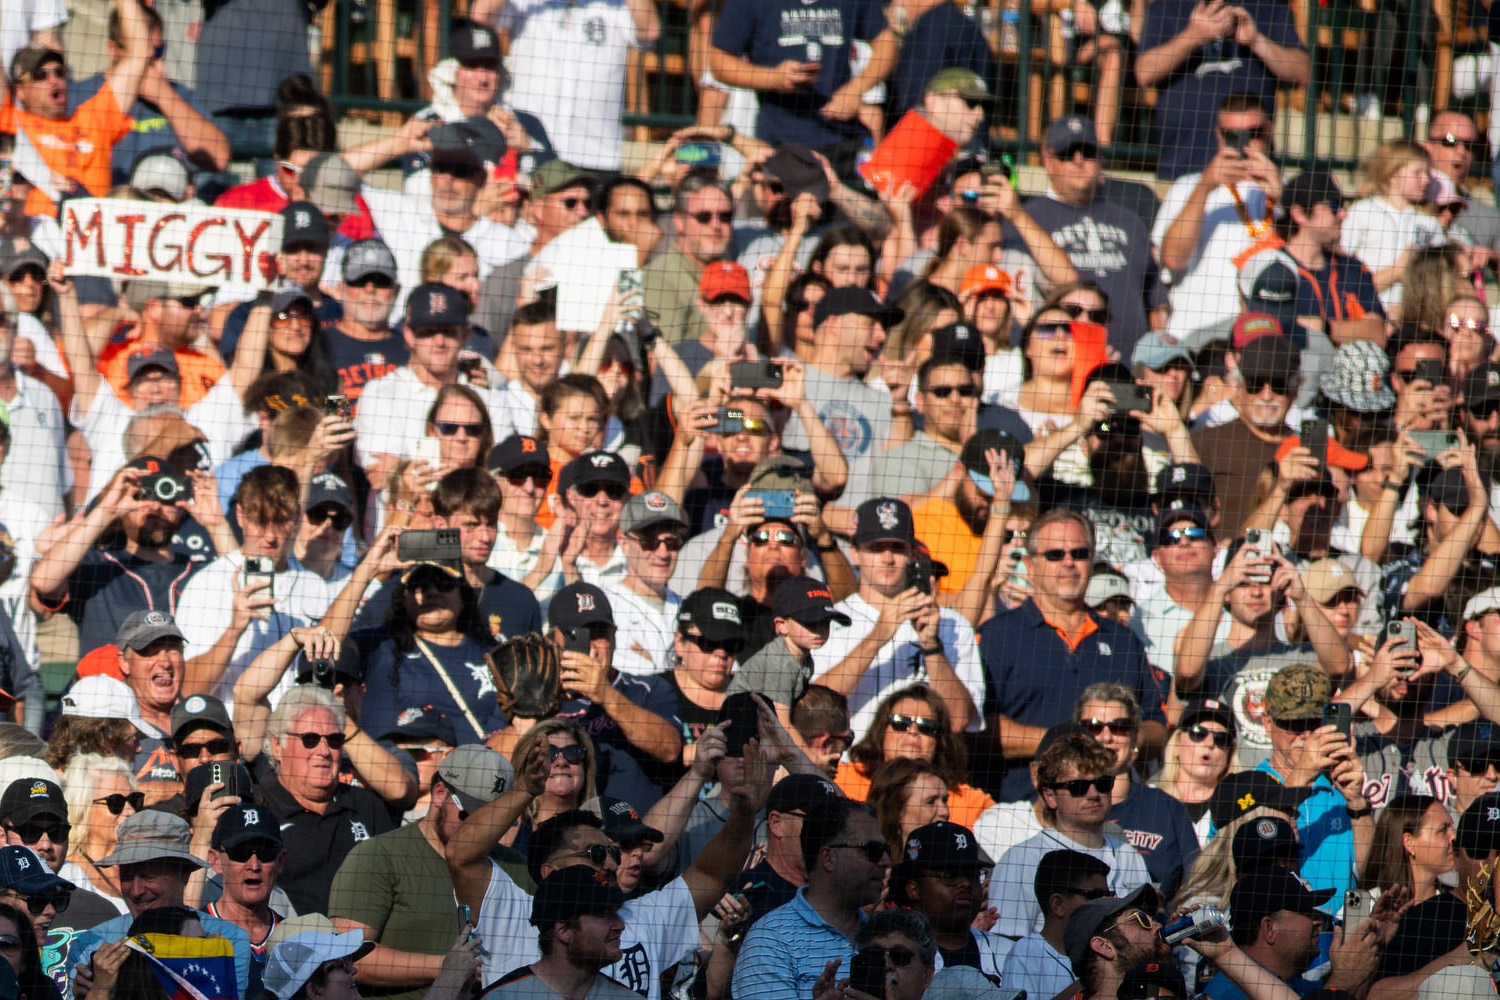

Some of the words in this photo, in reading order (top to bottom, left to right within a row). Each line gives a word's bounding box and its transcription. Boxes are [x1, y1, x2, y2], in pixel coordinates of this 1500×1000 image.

[65, 211, 268, 282] MIGGY
[591, 456, 614, 467] VT
[243, 808, 260, 827] D
[349, 820, 370, 842] D
[15, 857, 30, 871] D
